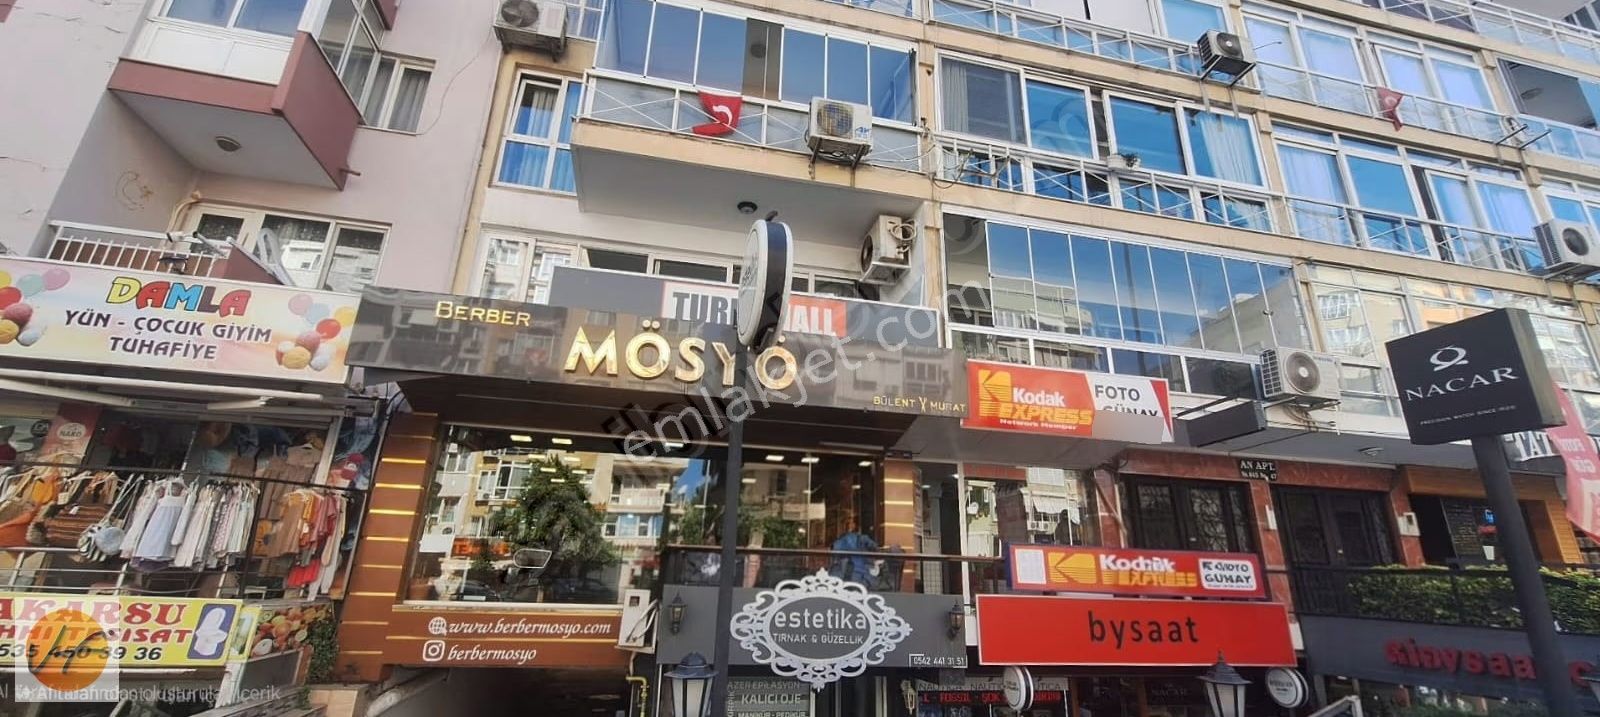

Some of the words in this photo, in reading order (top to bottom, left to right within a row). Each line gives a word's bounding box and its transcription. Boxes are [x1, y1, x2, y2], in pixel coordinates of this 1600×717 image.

[106, 276, 251, 317] DAMLA
[435, 300, 532, 328] BERBER
[65, 309, 111, 329] YÜN
[134, 316, 204, 339] ÇOCUK
[212, 321, 272, 343] GİYİM
[110, 335, 216, 360] TUHAFİYE
[563, 319, 797, 390] MÖSYÖ
[1094, 384, 1141, 402] FOTO
[1405, 366, 1520, 402] NACAR
[873, 395, 916, 408] BÜLENT
[929, 401, 966, 413] MURAT
[1013, 387, 1065, 407] Kodak
[999, 418, 1040, 428] Network
[1040, 422, 1077, 431] Member
[1000, 402, 1094, 427] EXPRESS
[448, 618, 612, 640] www.berbermosyo.com
[773, 607, 867, 630] estetika
[772, 633, 807, 643] TIRNAK
[1087, 610, 1199, 650] bysaat
[133, 646, 162, 661] 36
[447, 644, 537, 664] berbermosyo
[741, 693, 778, 704] KALICI
[781, 693, 801, 704] OJE
